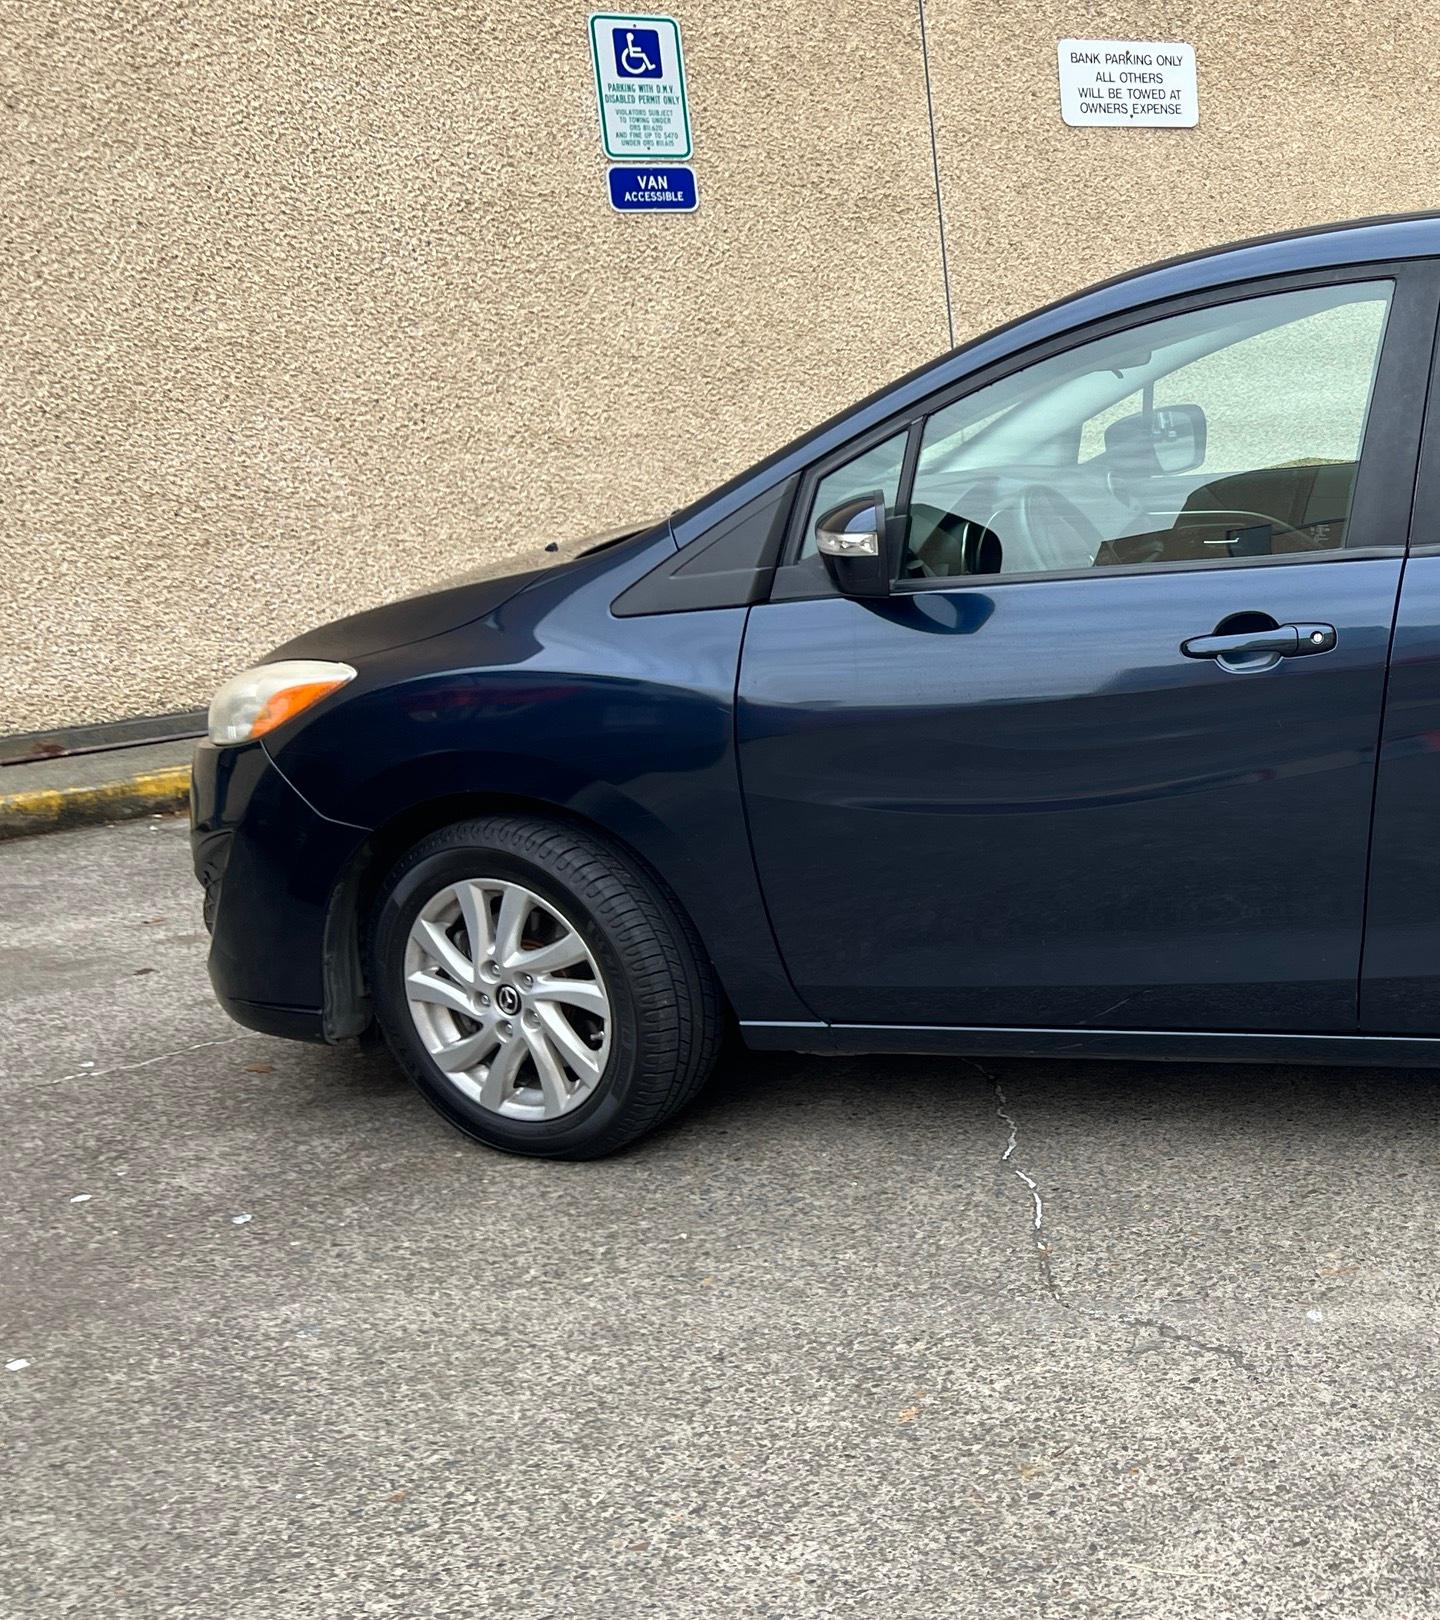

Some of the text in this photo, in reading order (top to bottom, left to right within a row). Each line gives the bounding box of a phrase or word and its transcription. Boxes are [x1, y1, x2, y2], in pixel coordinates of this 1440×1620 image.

[1070, 52, 1183, 67] BANK PARKING ONLY
[1095, 71, 1164, 84] ALL OTHERS
[607, 83, 636, 93] PARKING
[638, 84, 654, 94] WITH
[1078, 87, 1182, 100] WILL BE TOWED AT
[604, 94, 680, 105] DISABLED PERMIT ONLY
[648, 109, 673, 117] SUBJECT
[1080, 102, 1182, 115] OWNERS EXPENSE
[637, 175, 668, 190] VAN
[624, 191, 684, 202] ACCESSIBLE
